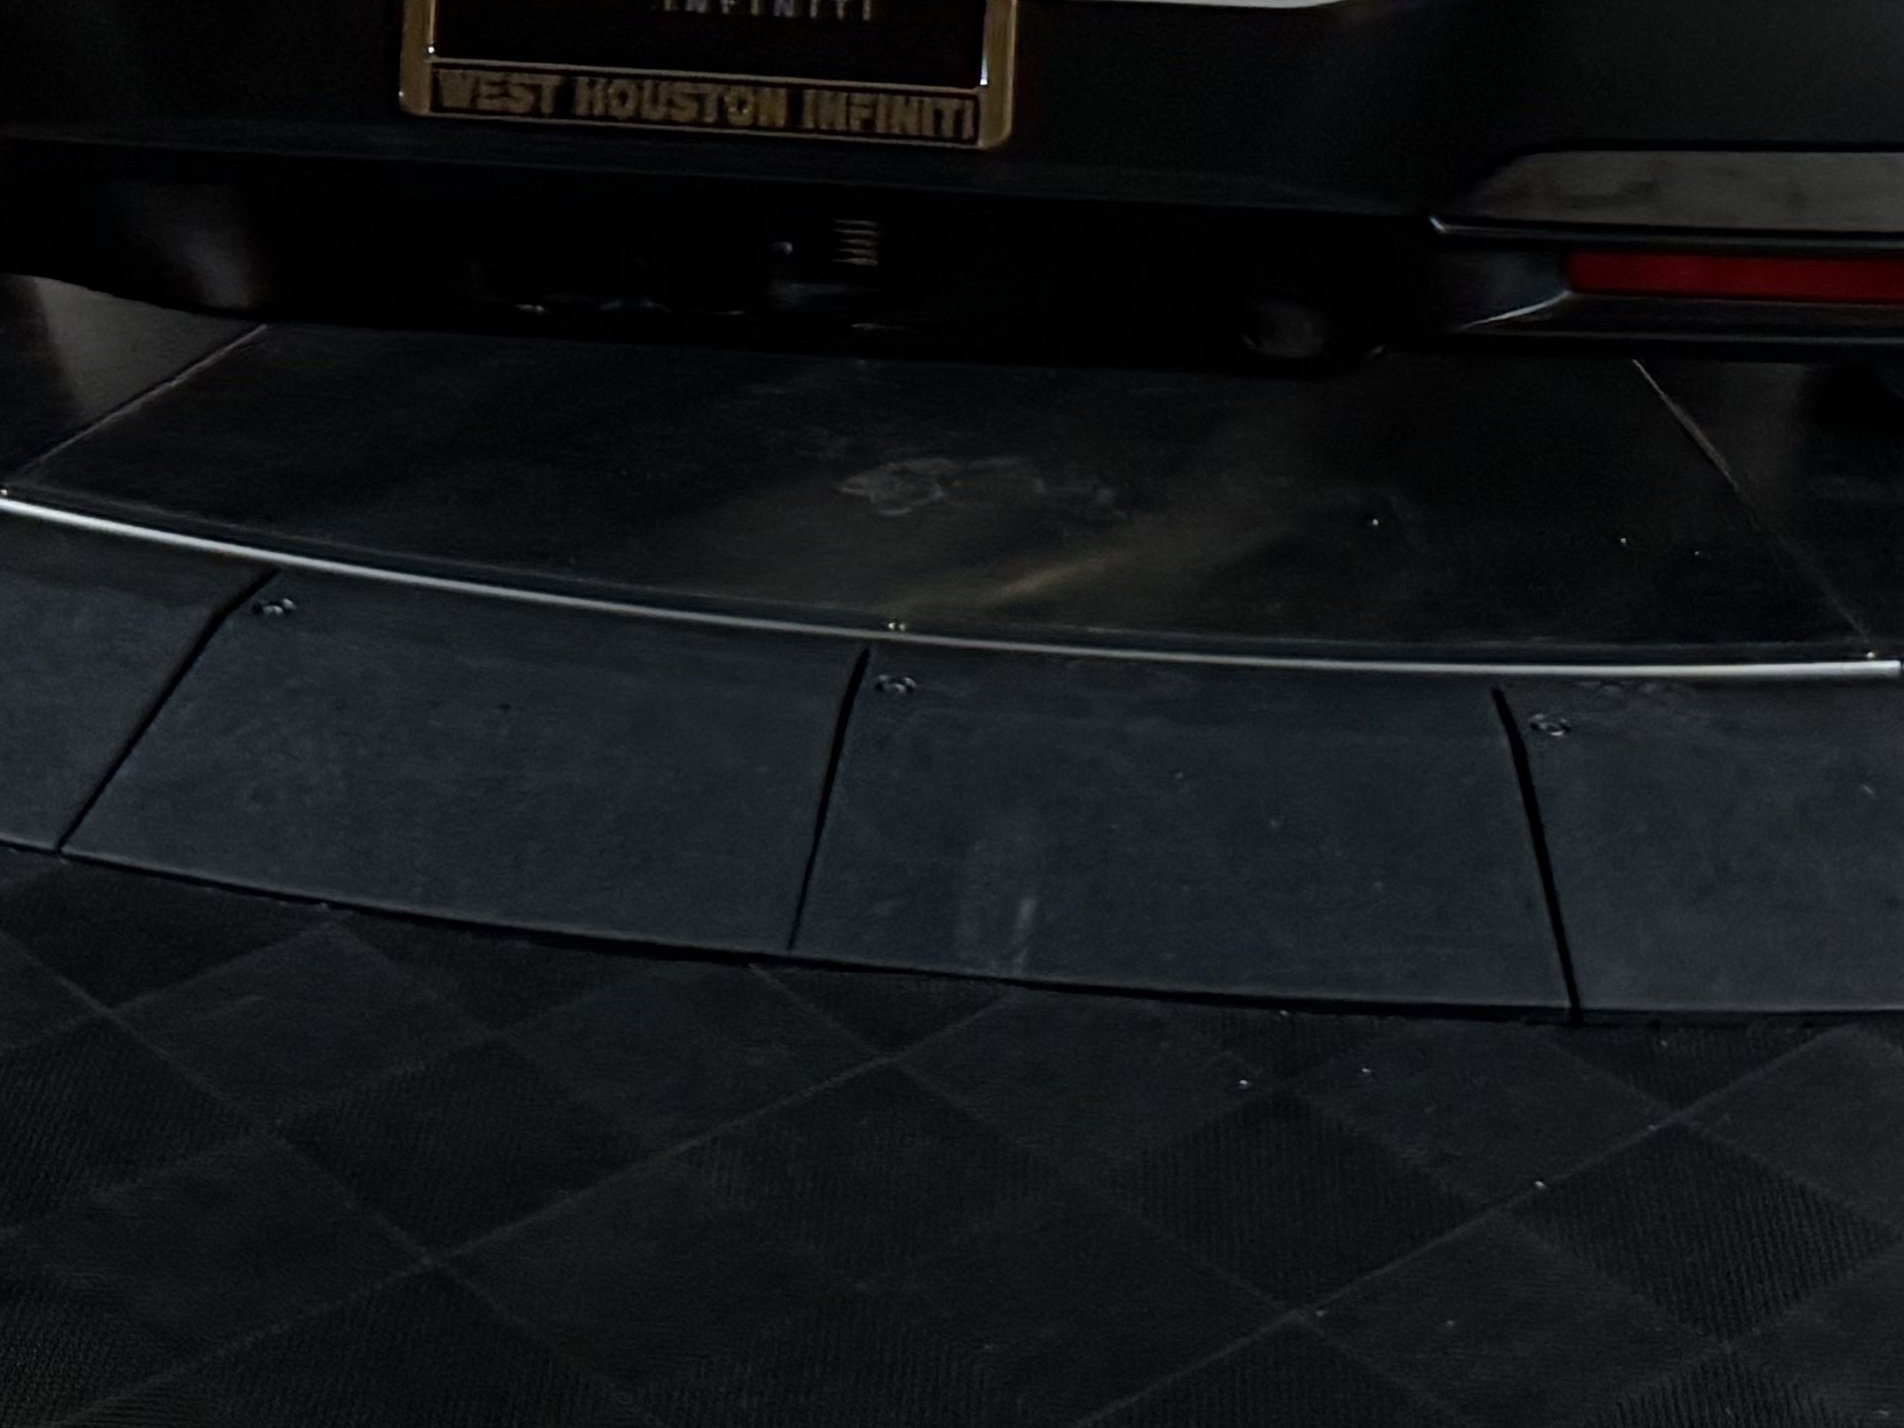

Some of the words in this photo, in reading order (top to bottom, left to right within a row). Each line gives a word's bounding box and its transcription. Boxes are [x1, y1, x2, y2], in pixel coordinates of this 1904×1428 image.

[436, 65, 564, 118] WEST
[573, 74, 789, 131] HOUSTON
[799, 87, 977, 141] INFINITI
